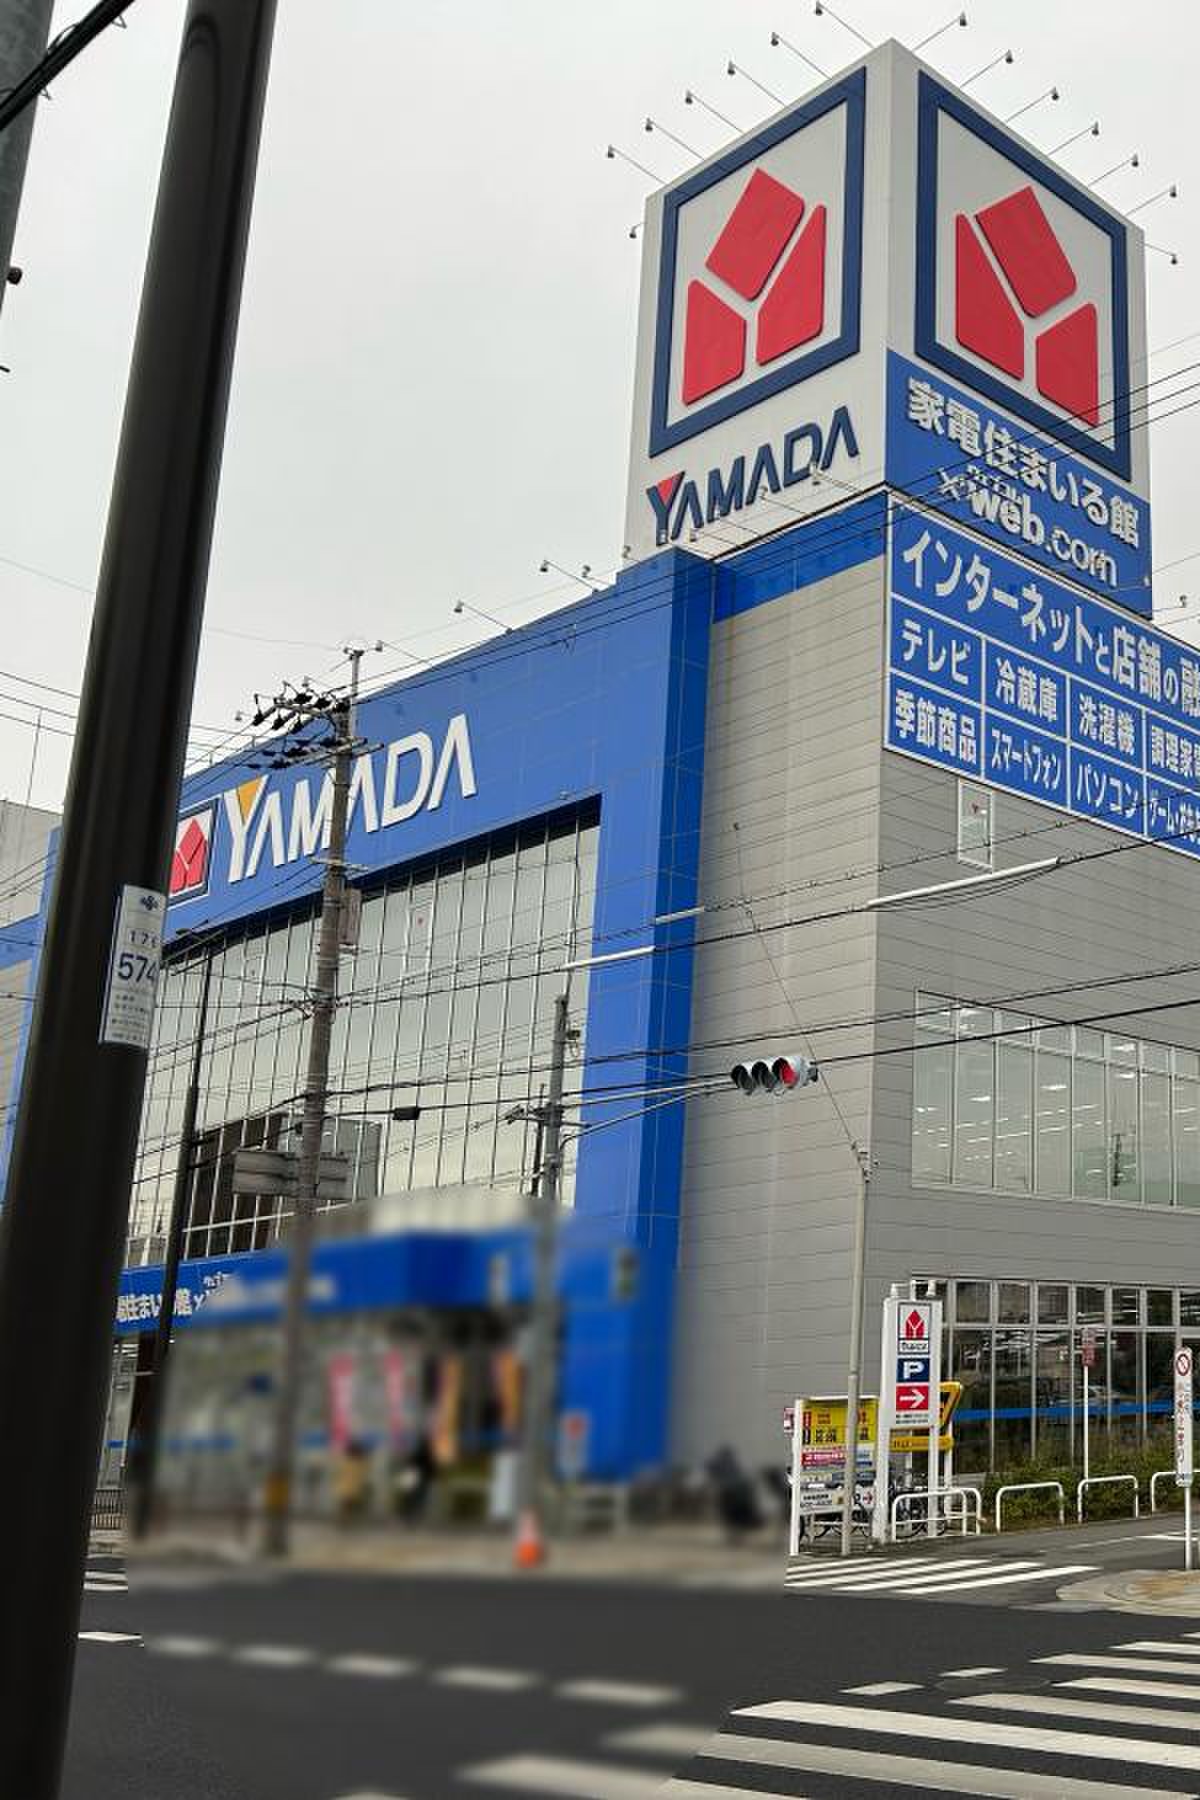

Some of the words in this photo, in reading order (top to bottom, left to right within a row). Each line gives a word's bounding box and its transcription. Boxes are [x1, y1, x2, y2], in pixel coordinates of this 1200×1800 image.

[646, 406, 859, 546] YAMADA
[907, 378, 1139, 549] 家電住まいる館
[902, 619, 971, 685] テレビ
[995, 657, 1057, 721] 冷蔵庫
[896, 688, 977, 765] 季節商品
[1079, 693, 1135, 755] 洗濯機
[992, 729, 1061, 790] スマートフォン
[1077, 763, 1138, 818] パソコン
[223, 713, 477, 884] YAMADA
[903, 1361, 925, 1379] P
